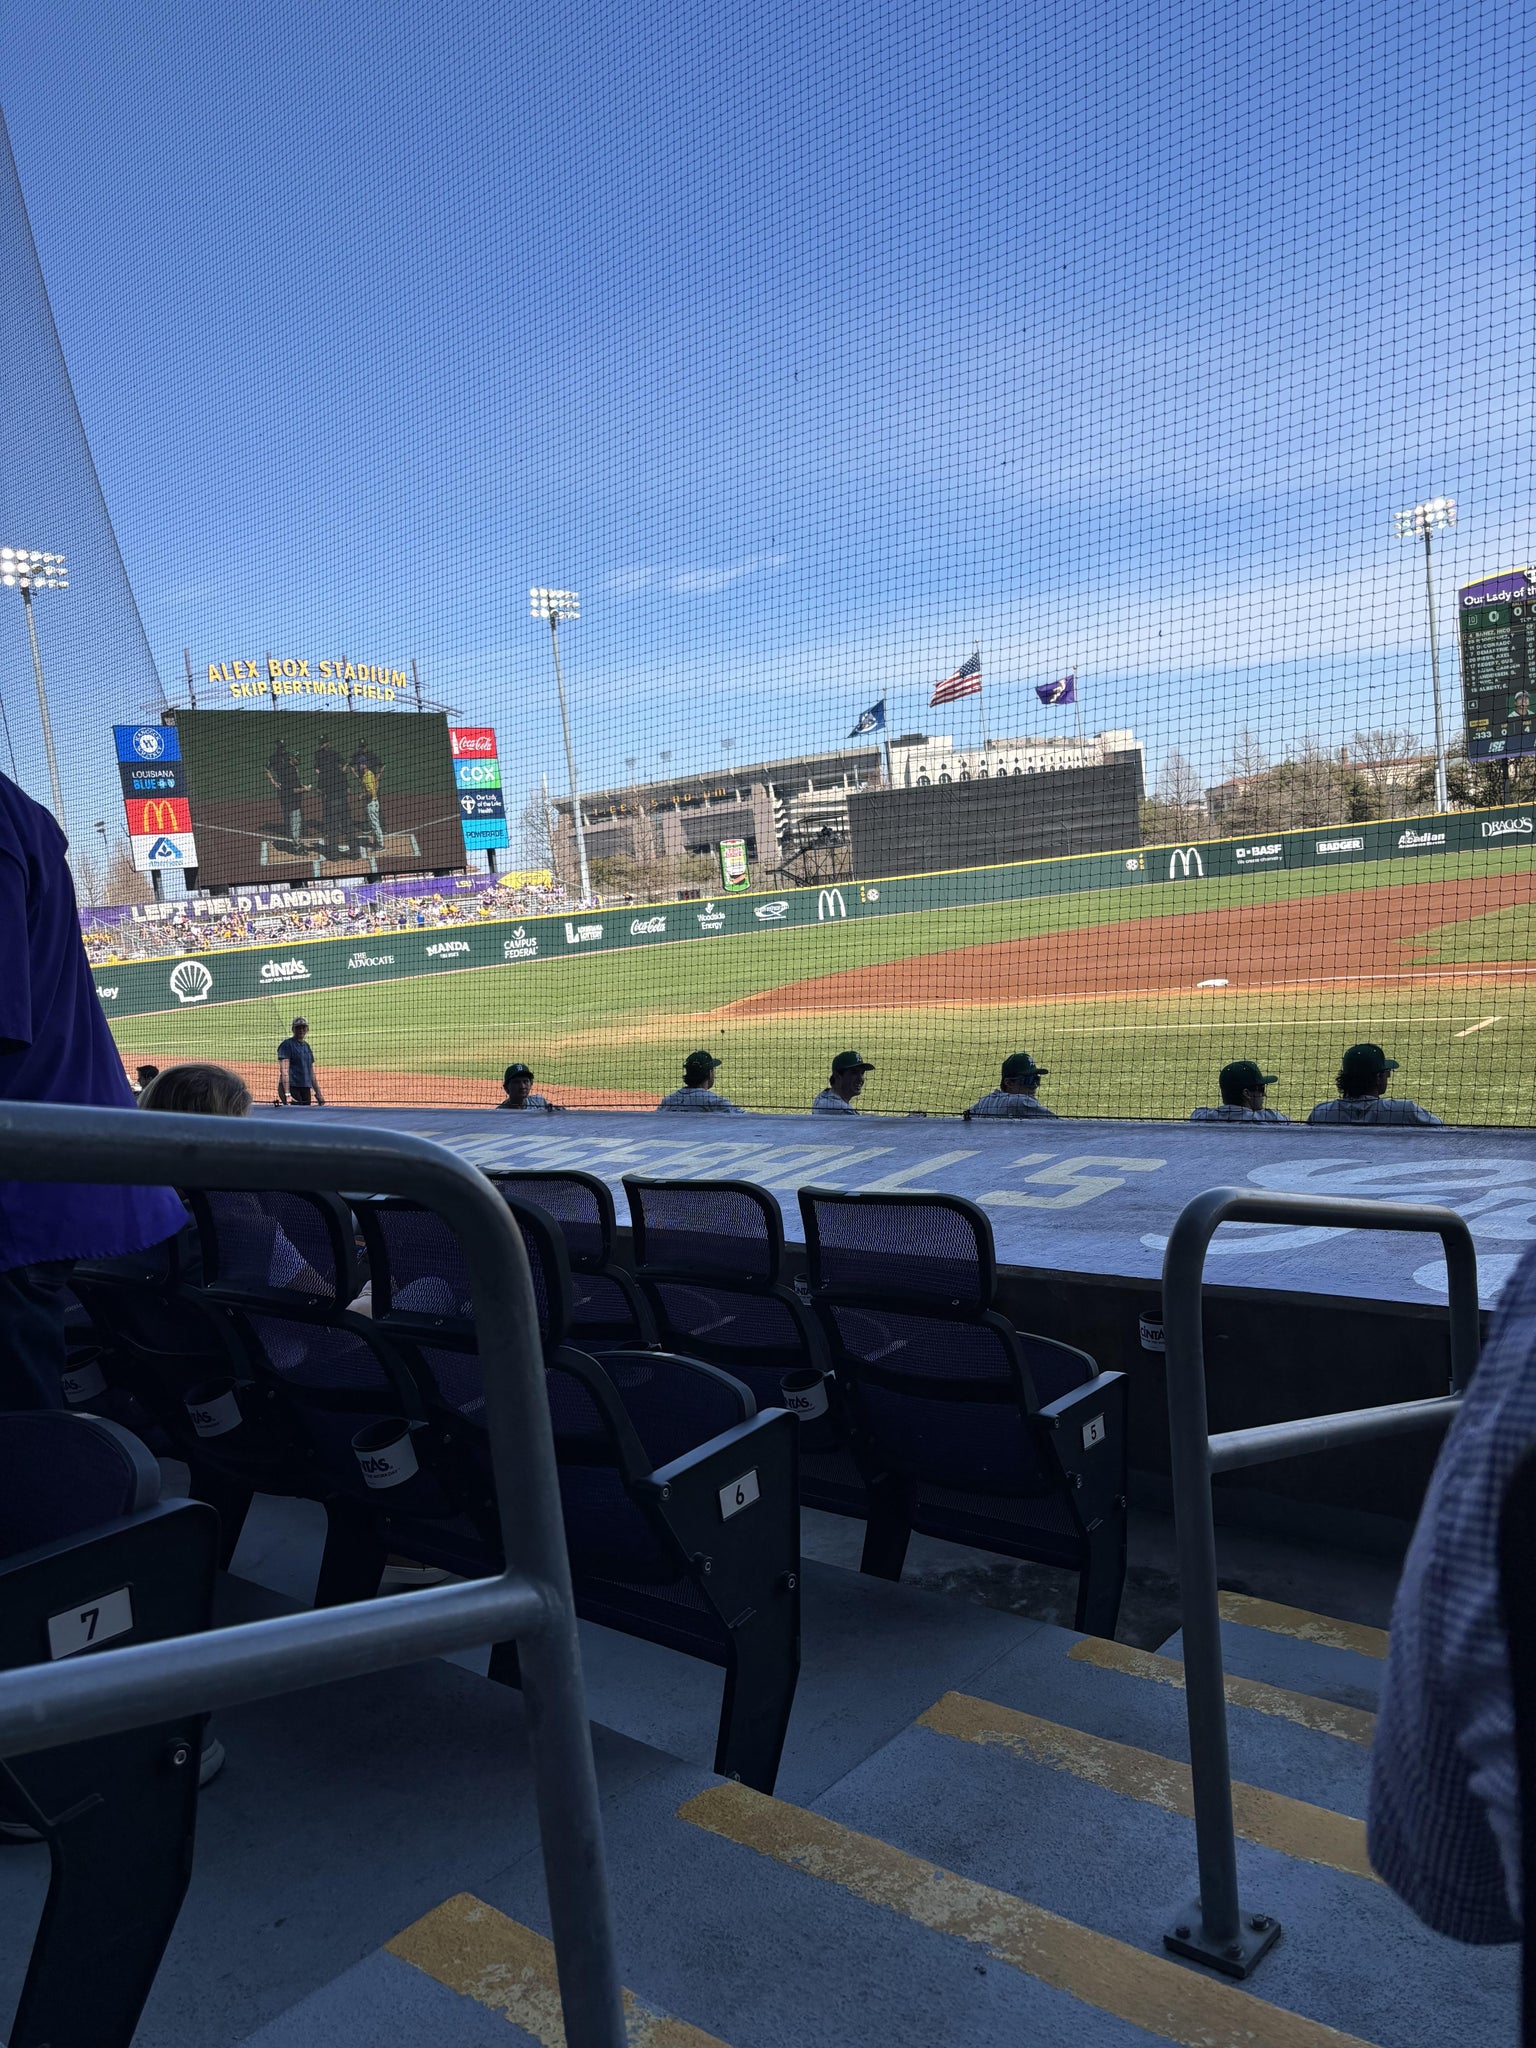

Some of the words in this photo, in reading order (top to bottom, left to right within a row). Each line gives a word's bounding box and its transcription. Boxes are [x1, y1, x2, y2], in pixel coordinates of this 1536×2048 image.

[1464, 596, 1484, 605] Our
[1486, 590, 1511, 602] Lady
[1513, 587, 1525, 598] of
[208, 660, 260, 683] ALEX
[268, 659, 310, 677] BOX
[319, 660, 407, 688] STADIUM
[230, 681, 268, 698] SKIP
[271, 680, 349, 696] BERTMAN
[354, 683, 395, 701] FIELD
[132, 770, 175, 778] LOUISIANA
[460, 766, 495, 782] COX
[133, 779, 156, 790] BLUE
[1481, 816, 1533, 837] DRAGO'S
[466, 830, 504, 838] POWERADE
[1398, 832, 1446, 845] Acadian
[1251, 844, 1282, 856] BASF
[1319, 839, 1361, 853] BADGER
[131, 902, 188, 923] LEFT
[193, 896, 251, 917] FIELD
[254, 889, 345, 911] LANDING
[697, 912, 726, 922] Woodside
[701, 920, 723, 931] Energy
[425, 941, 471, 957] MANDA
[503, 937, 537, 950] CAMPUS
[353, 952, 367, 961] THE
[504, 947, 537, 959] FEDERAL
[347, 955, 395, 970] ADVOCATE
[96, 986, 119, 1000] ley
[1090, 1424, 1098, 1441] 5
[735, 1485, 745, 1506] 6
[80, 1607, 99, 1641] 7
